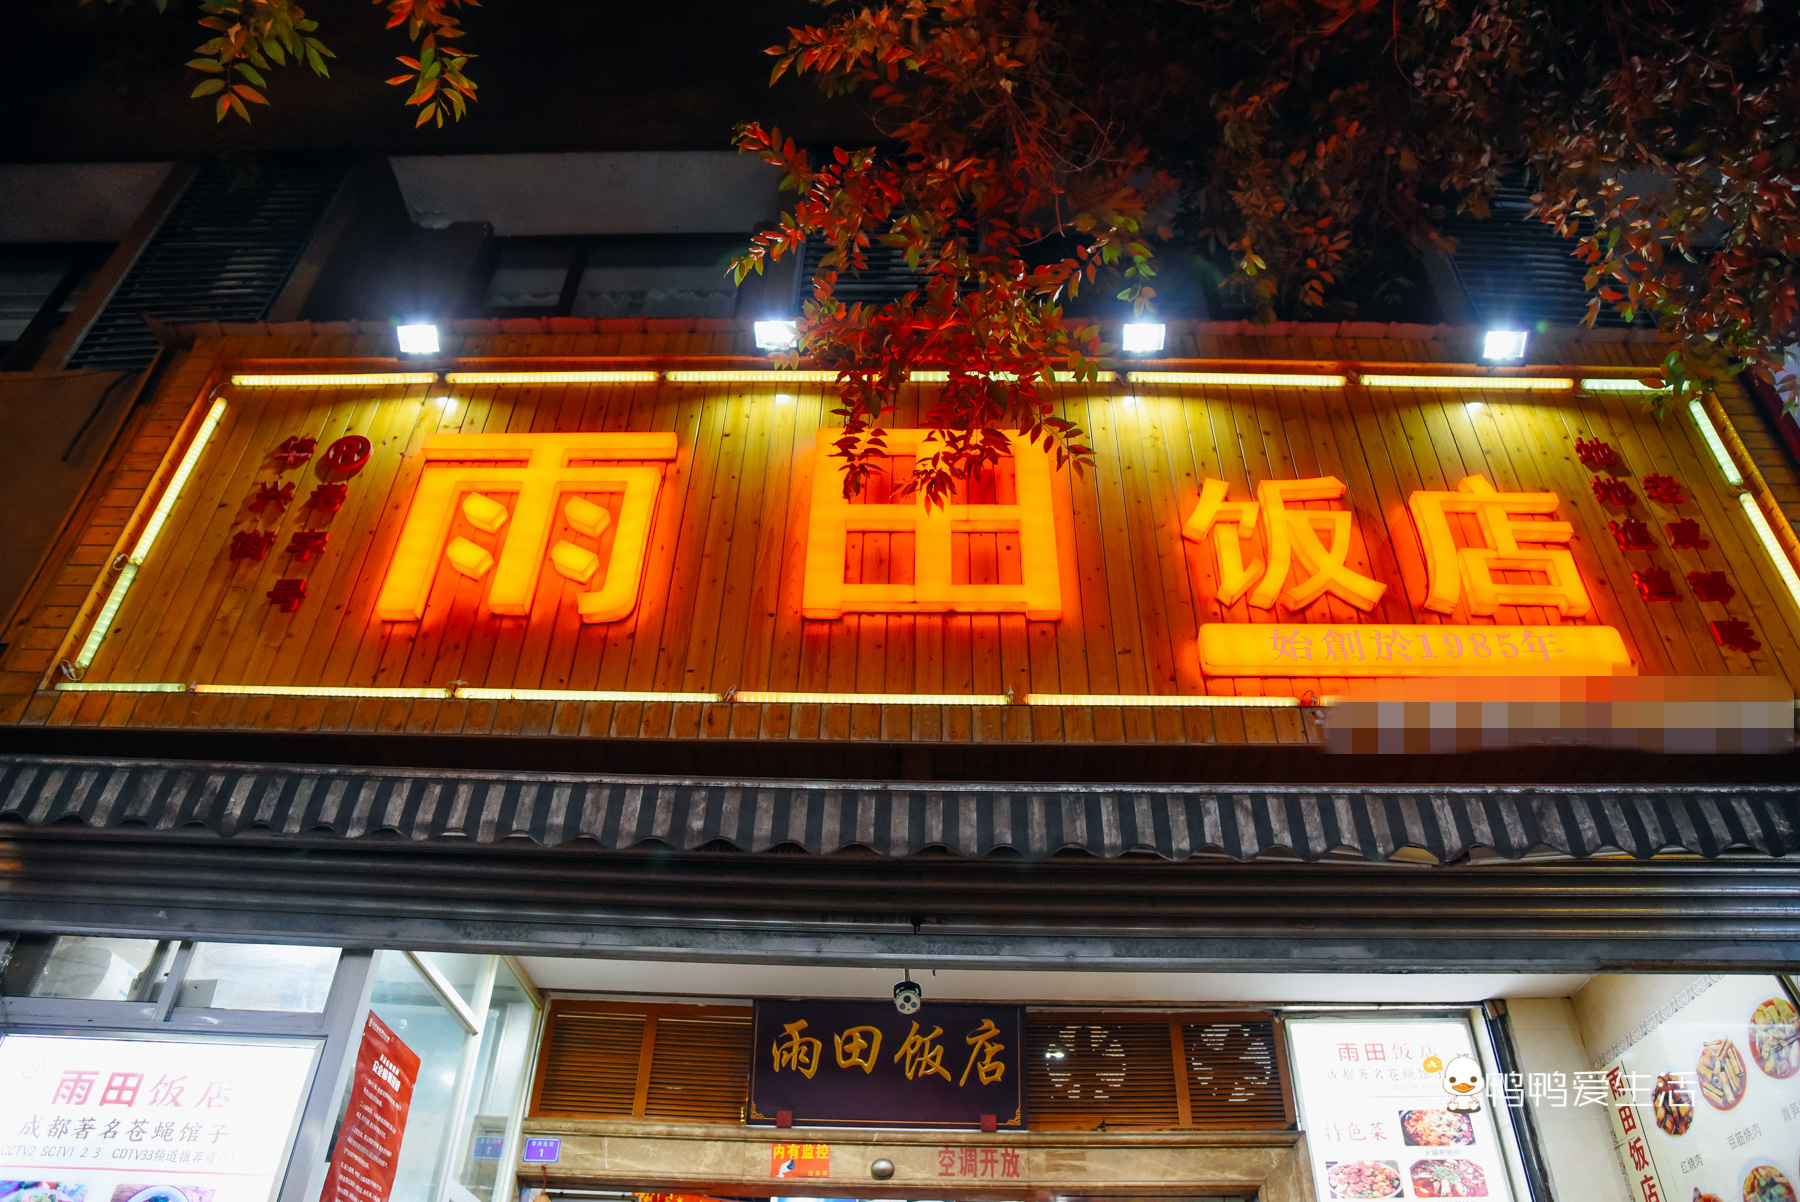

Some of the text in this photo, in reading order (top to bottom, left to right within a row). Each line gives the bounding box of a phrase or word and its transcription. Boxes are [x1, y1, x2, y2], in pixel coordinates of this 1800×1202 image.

[376, 427, 1591, 624] 雨田饭店
[1268, 628, 1563, 663] 始創於1985年
[771, 1018, 1007, 1087] 雨田饭店
[51, 1069, 237, 1110] 雨田饭店
[1780, 1098, 1800, 1123] 青笋
[17, 1113, 231, 1146] 成都著名苍蝇馆子
[1726, 1123, 1762, 1150] 豆筋烧肉
[539, 1148, 545, 1158] 1
[773, 1143, 830, 1159] 内有监控
[937, 1147, 1021, 1178] 空调开放
[1680, 1154, 1704, 1174] 红烧肉
